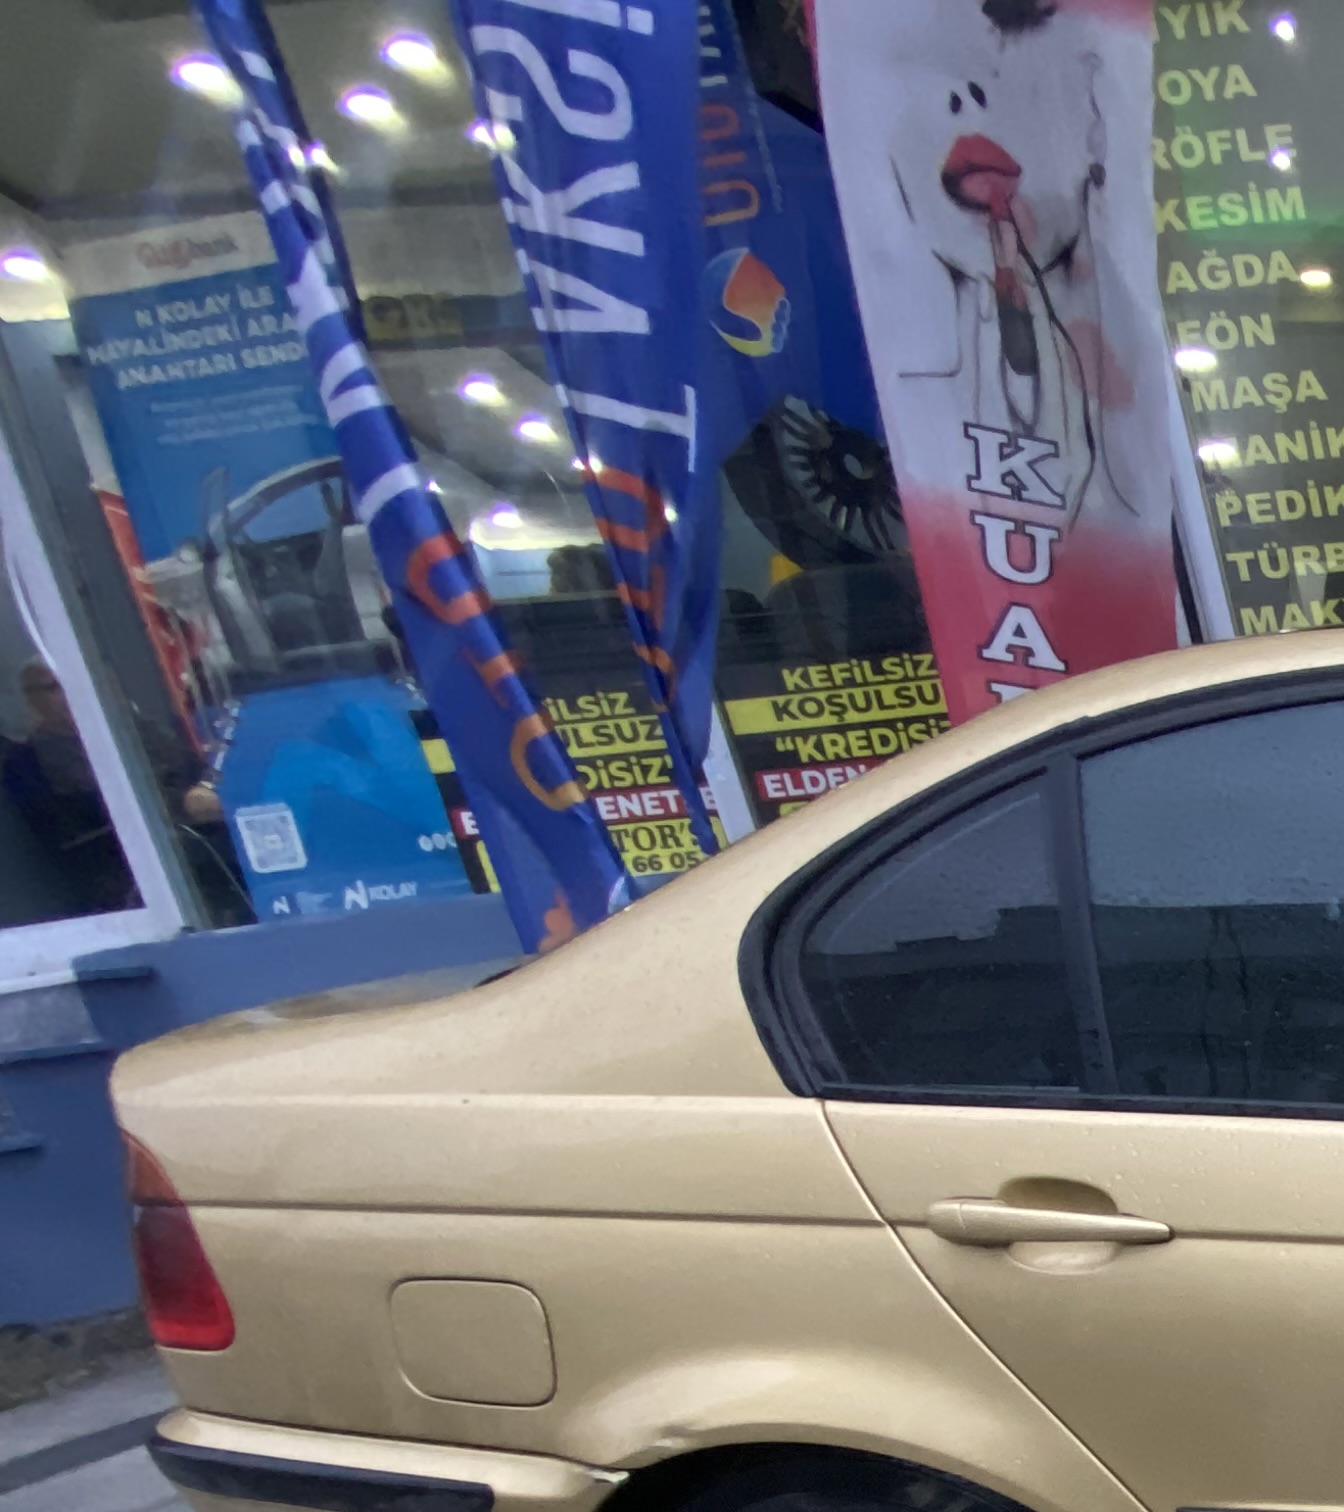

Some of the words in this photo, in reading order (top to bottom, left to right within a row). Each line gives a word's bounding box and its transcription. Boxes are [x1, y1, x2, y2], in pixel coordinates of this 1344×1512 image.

[1152, 0, 1251, 41] YIK
[1157, 63, 1258, 106] OYA
[1154, 181, 1307, 234] KESİM
[1166, 249, 1300, 294] AĞDA
[1176, 310, 1276, 351] FÖN
[1190, 368, 1329, 414] MAŞA
[771, 683, 941, 723] KOŞULSU
